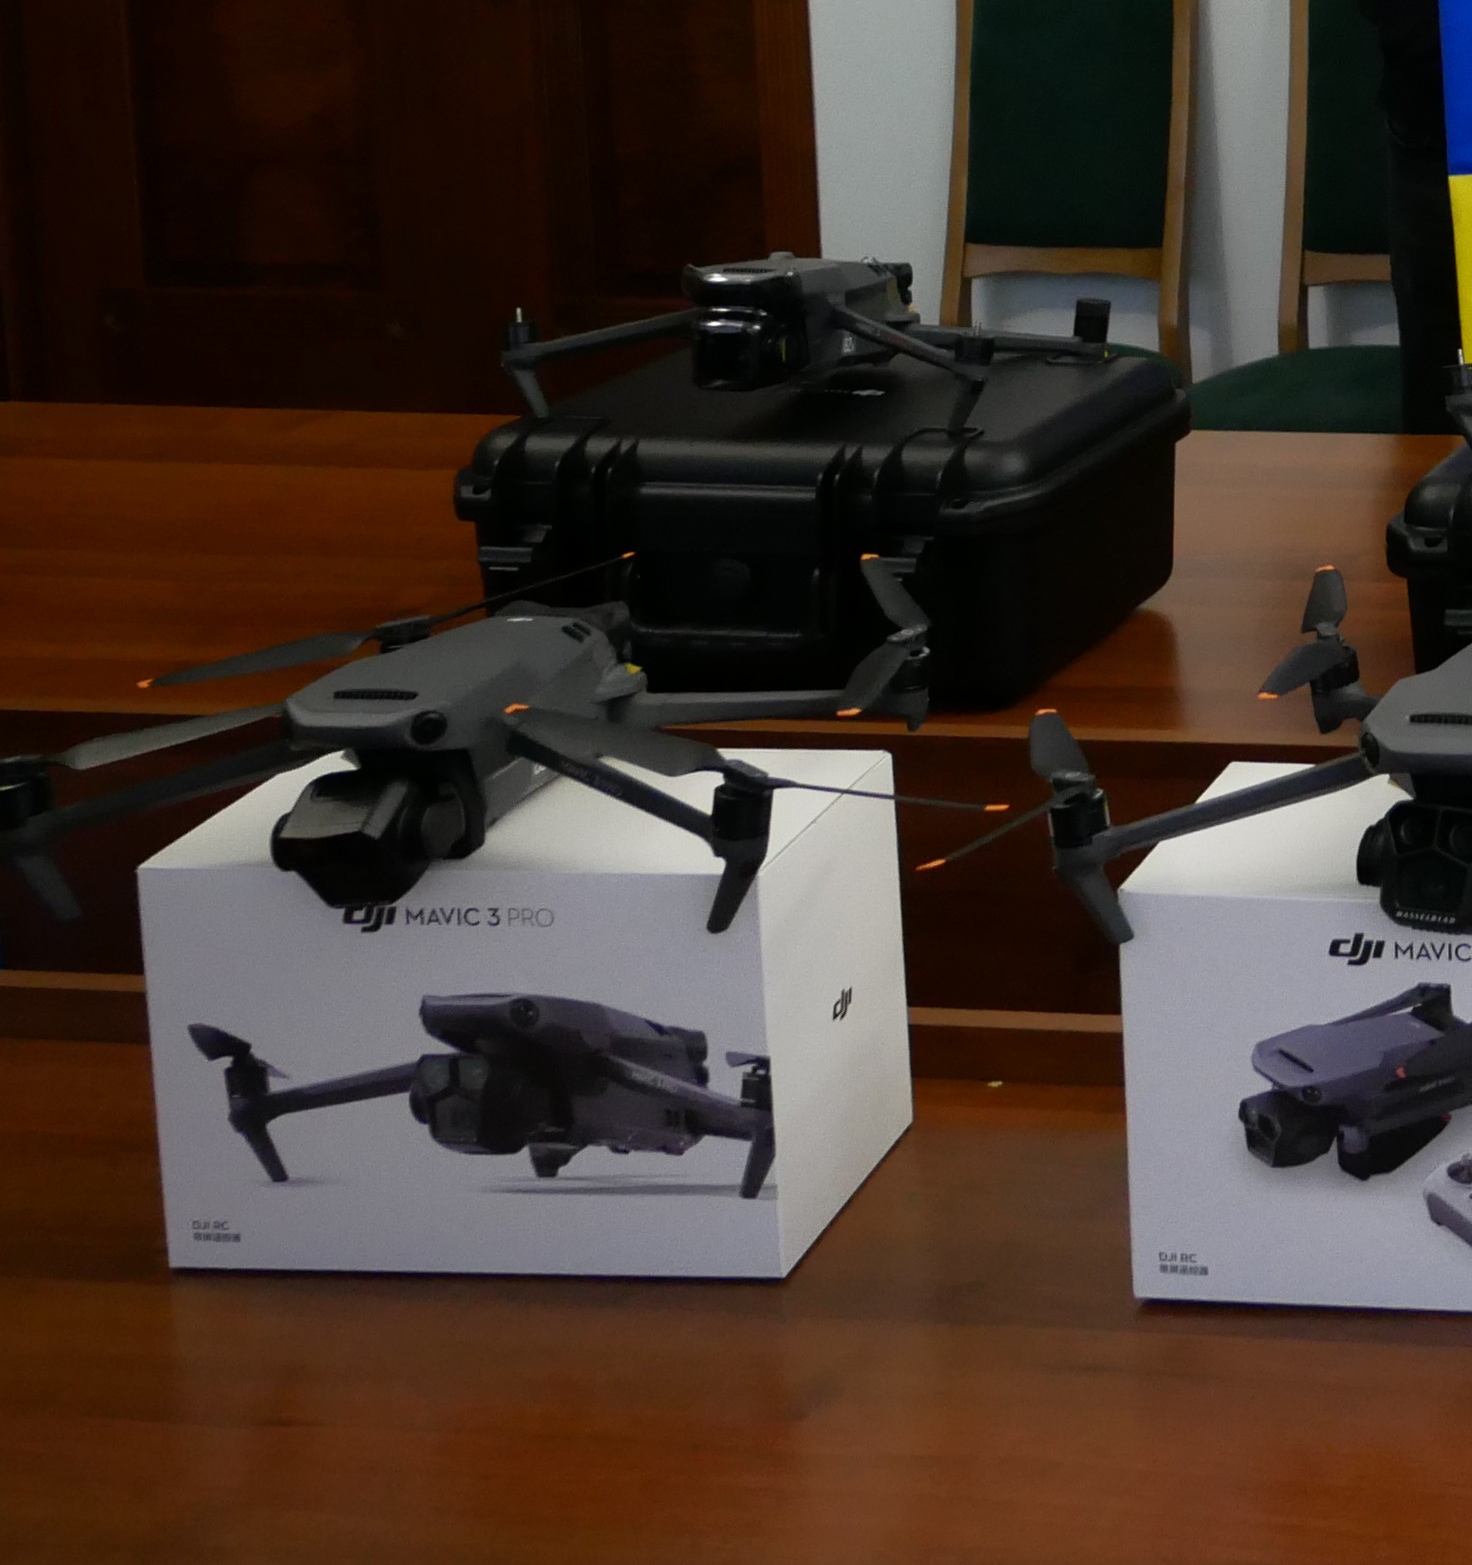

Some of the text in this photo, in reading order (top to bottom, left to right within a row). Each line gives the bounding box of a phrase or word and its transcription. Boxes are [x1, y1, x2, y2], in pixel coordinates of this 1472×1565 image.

[405, 906, 480, 927] MAVIC
[486, 907, 501, 927] 3
[507, 907, 555, 928] PRO
[1394, 942, 1472, 963] MAVIC
